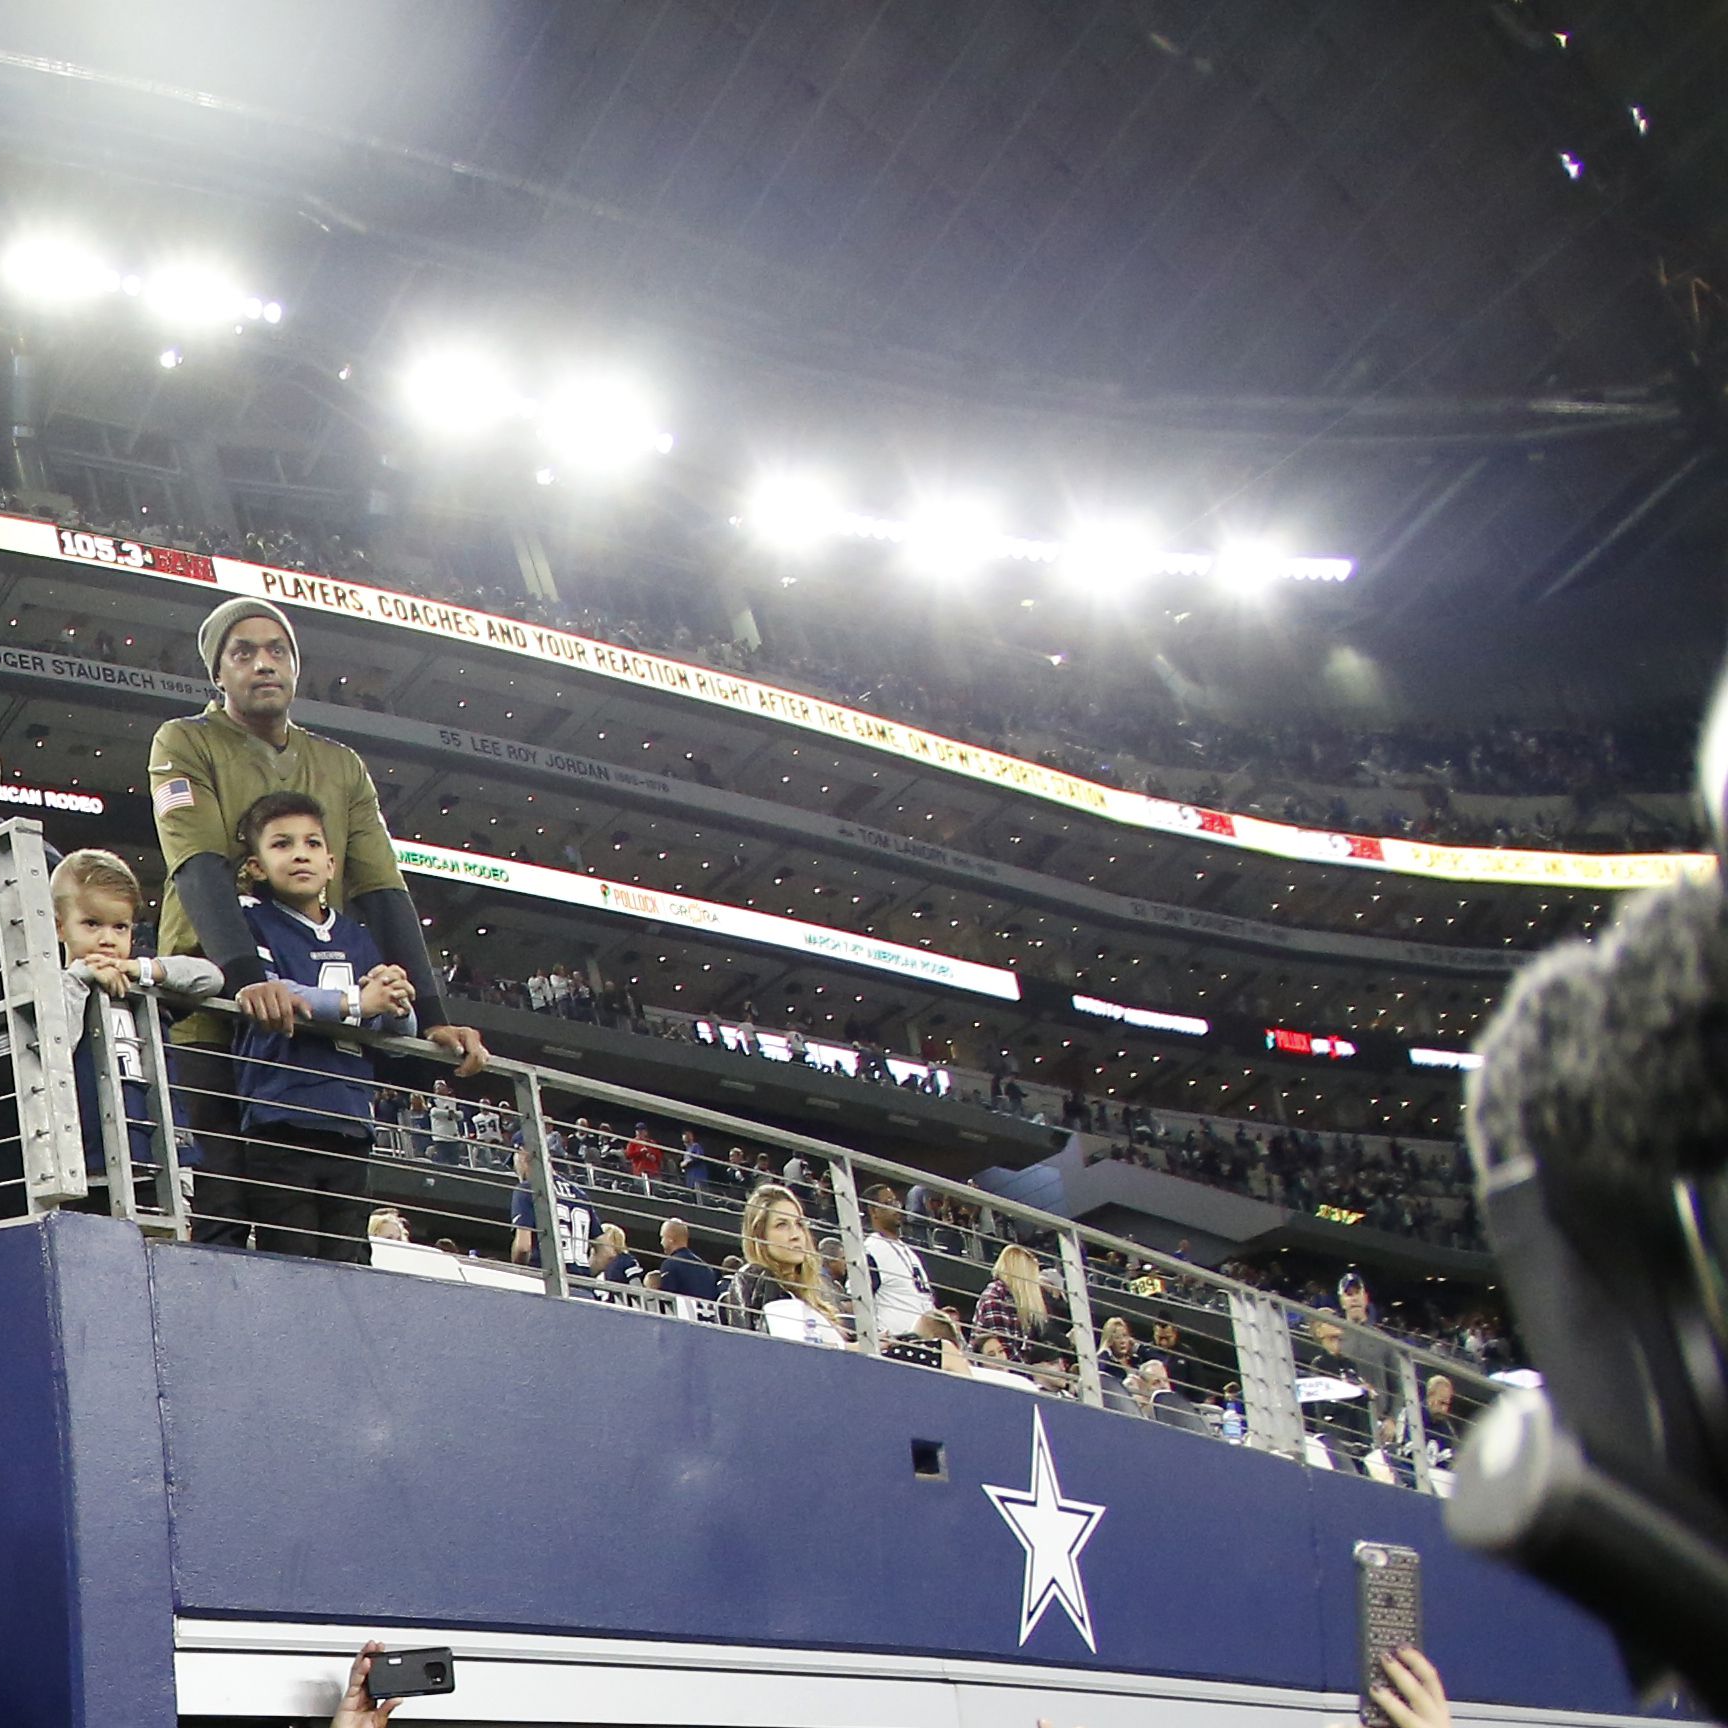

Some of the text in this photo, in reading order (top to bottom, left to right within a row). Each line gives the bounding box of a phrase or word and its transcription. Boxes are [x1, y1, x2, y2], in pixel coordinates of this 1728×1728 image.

[60, 531, 144, 568] 105.3
[52, 660, 155, 690] STAUBACH
[262, 571, 372, 617] PLAYERS,
[378, 595, 480, 638] COACHES
[486, 620, 528, 650] AND
[532, 631, 588, 662] YOUR
[593, 646, 689, 691] REACTION
[696, 672, 750, 707] RIGHT
[759, 690, 810, 723] AFTER
[815, 705, 849, 734] THE
[909, 733, 931, 756] ON
[440, 731, 611, 781] 55 LEE ROY JORDAN
[45, 791, 104, 815] RODEO
[858, 828, 889, 847] TOM
[463, 861, 509, 883] RODEO
[614, 889, 659, 914] POLLOCK
